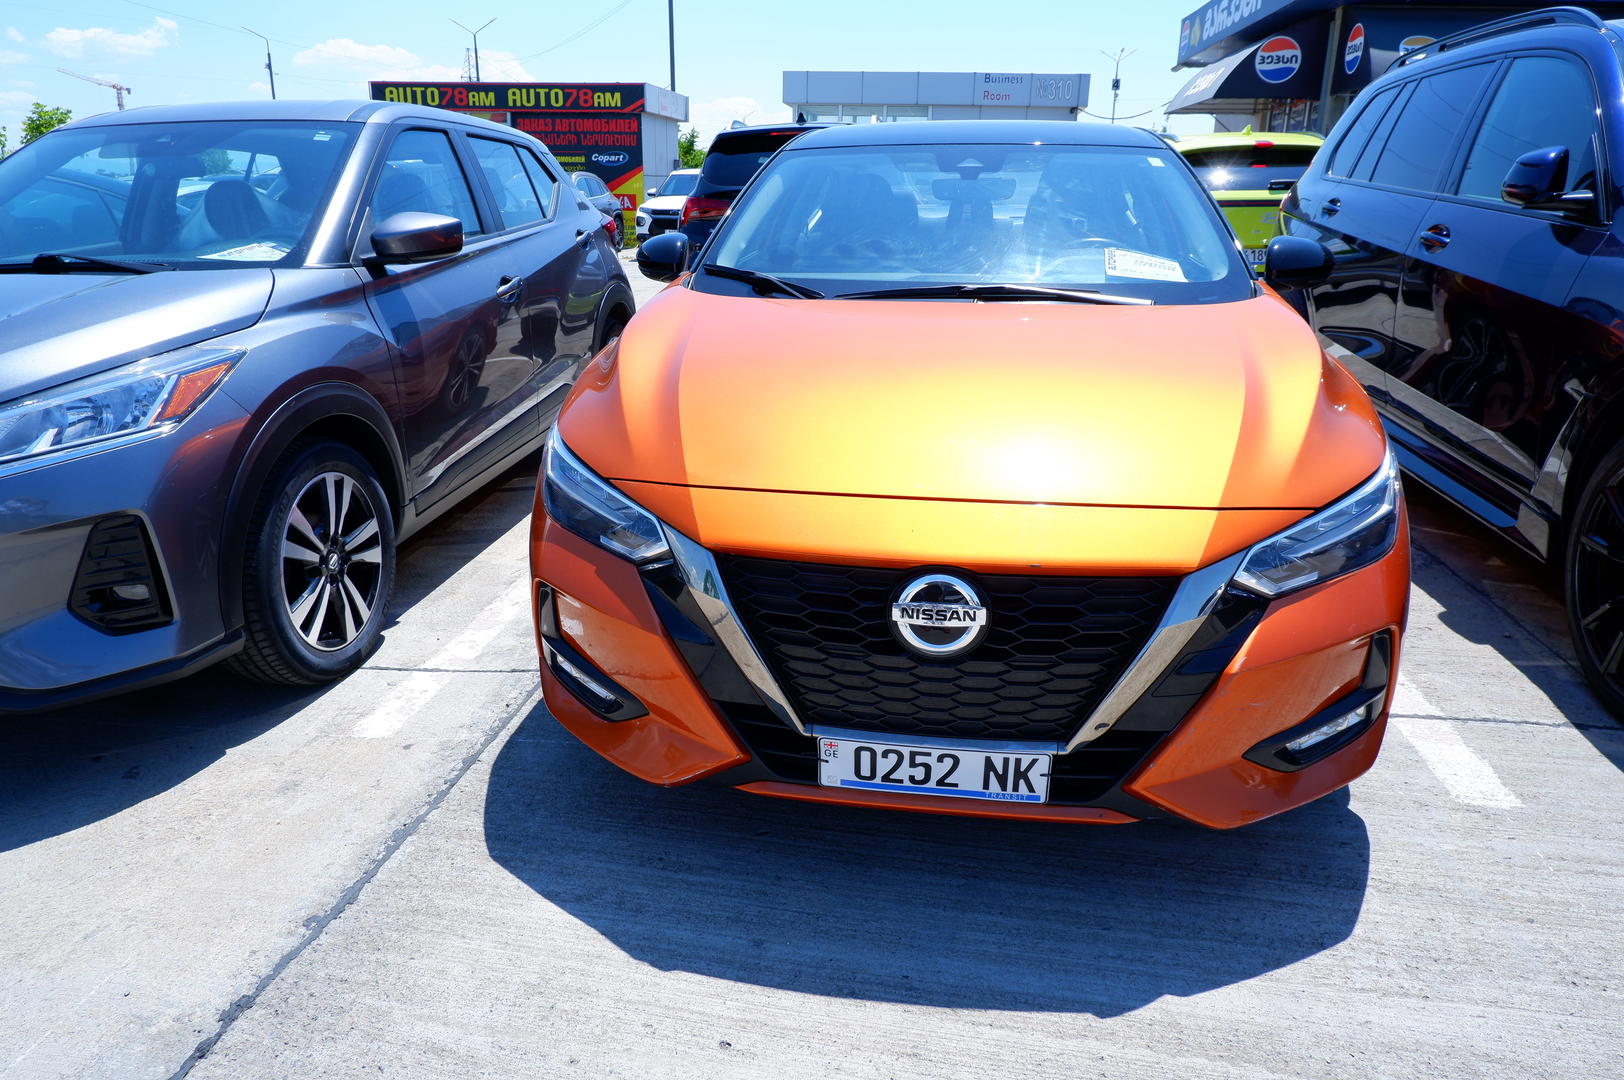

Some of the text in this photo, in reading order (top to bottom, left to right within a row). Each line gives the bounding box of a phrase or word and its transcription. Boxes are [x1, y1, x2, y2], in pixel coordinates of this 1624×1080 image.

[984, 73, 1023, 84] Business
[384, 86, 621, 108] AUTO78AM AUTO78AM
[983, 90, 1010, 101] Room
[516, 117, 638, 132] ЗАКАЗ АВТОМОБИЛЕЙ
[591, 153, 625, 163] Copart
[900, 606, 977, 622] NISSAN
[824, 749, 839, 758] GE
[853, 745, 1040, 793] 0252 NK
[984, 791, 1026, 800] TRANSIT
